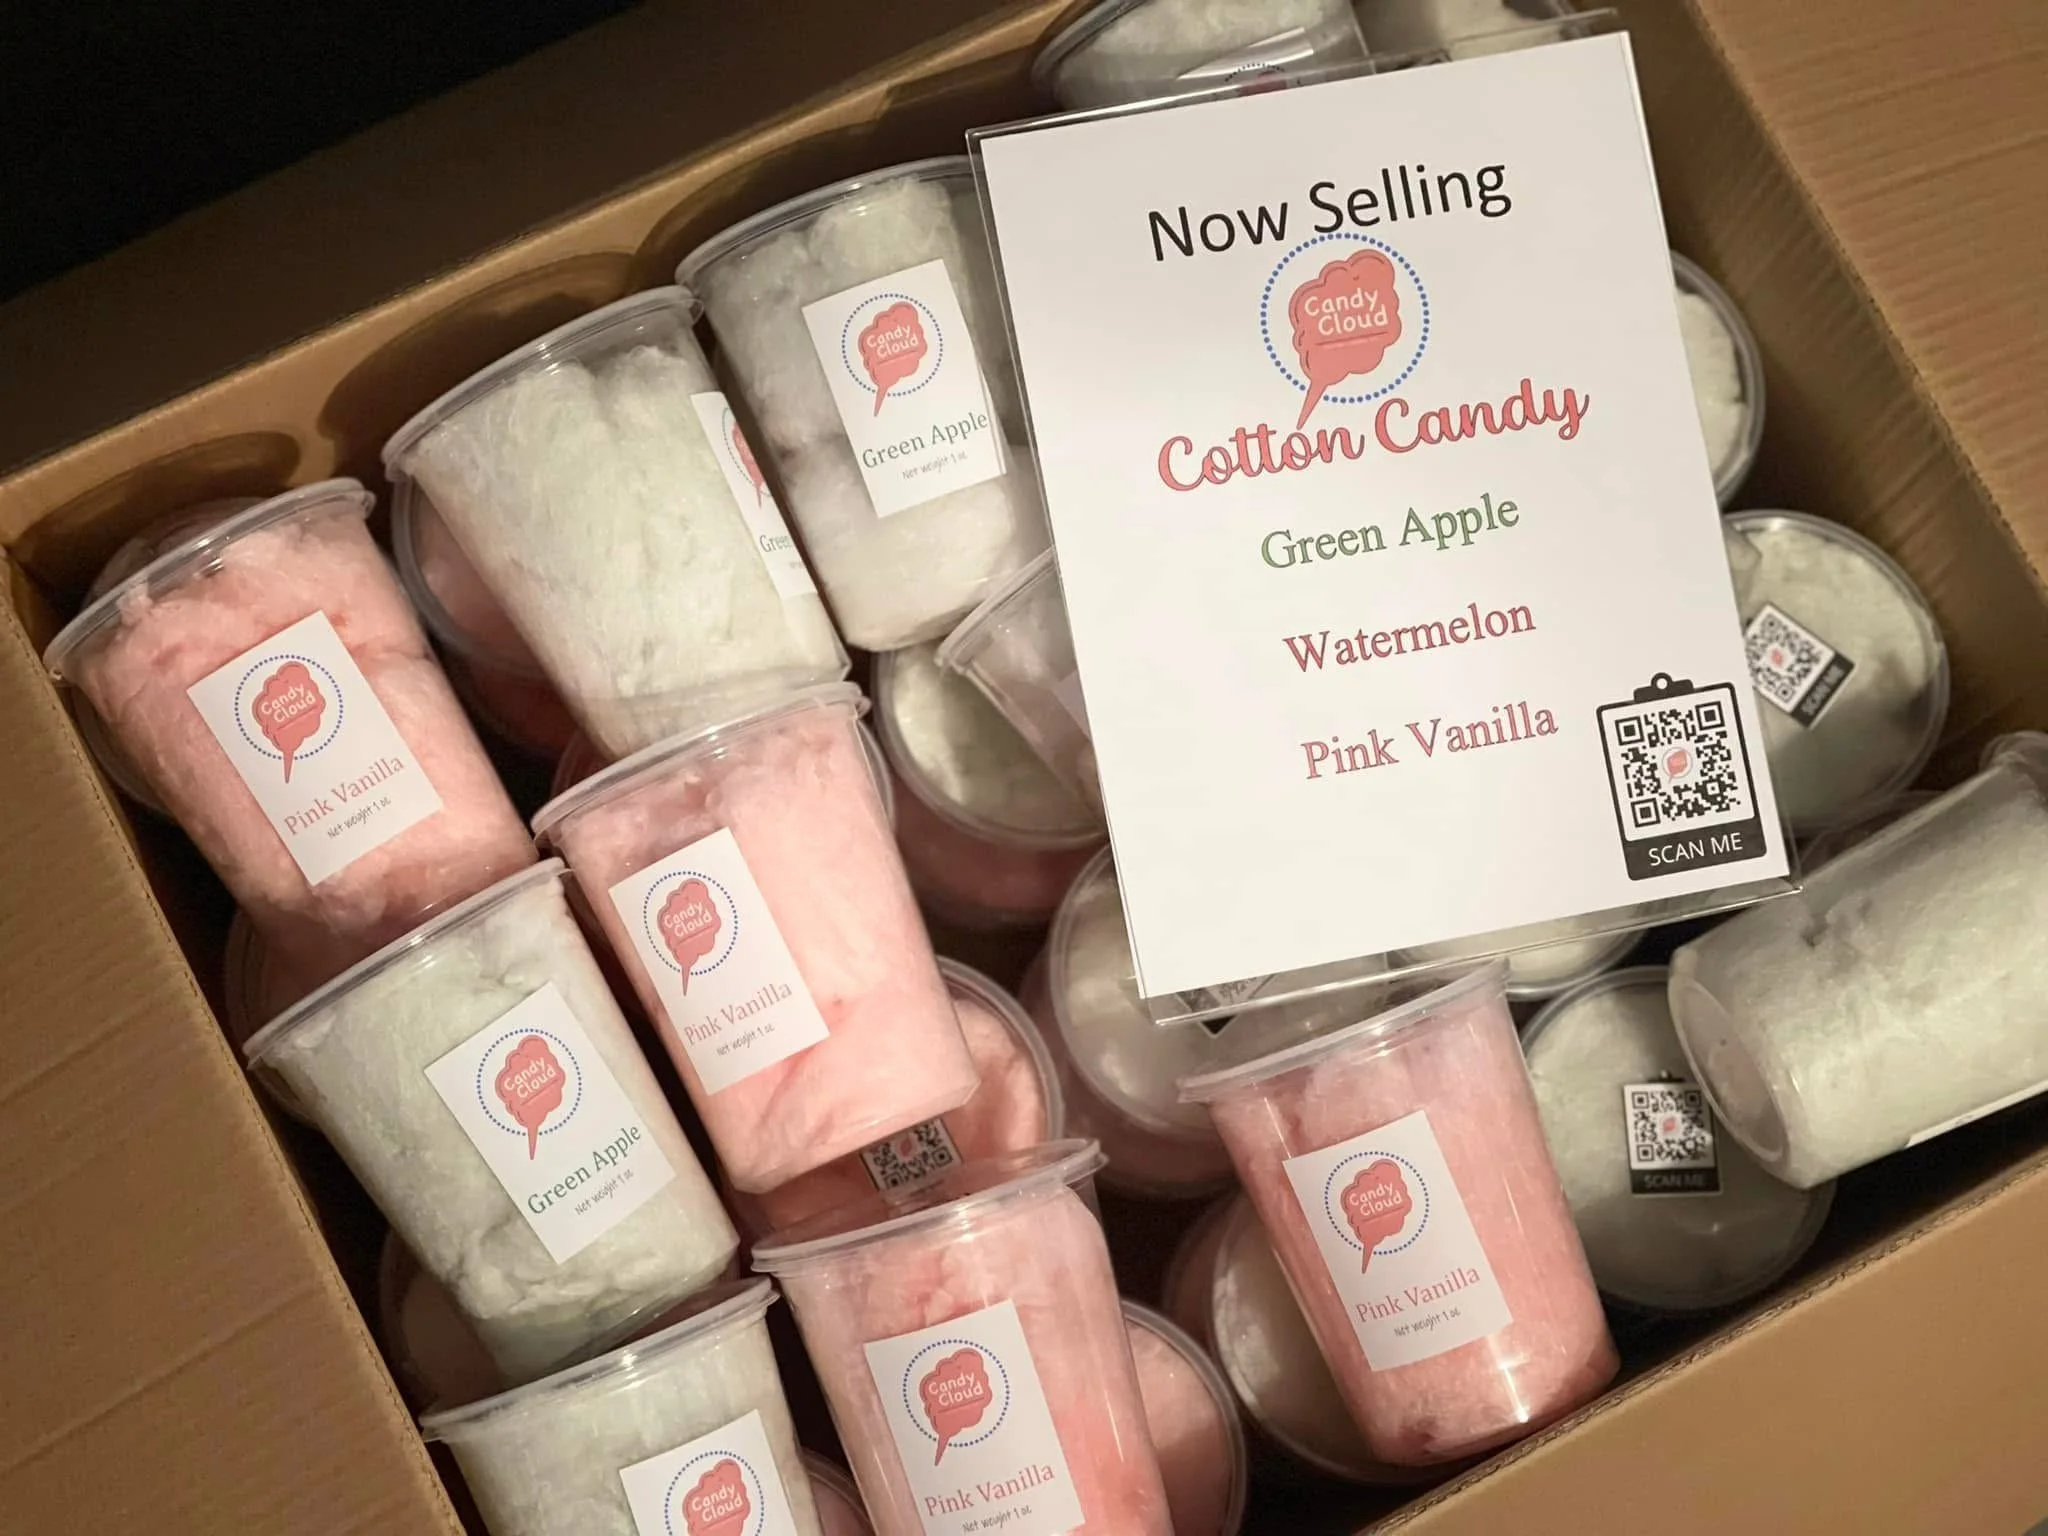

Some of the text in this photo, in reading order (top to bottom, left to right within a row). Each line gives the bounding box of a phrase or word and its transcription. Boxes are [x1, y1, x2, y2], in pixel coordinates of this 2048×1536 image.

[1148, 163, 1512, 262] Now Selling
[1304, 286, 1379, 317] Candy
[867, 325, 910, 348] Candy
[1317, 306, 1389, 338] Cloud
[877, 333, 918, 359] Cloud
[862, 411, 988, 469] Green Apple
[1158, 378, 1590, 491] Cotton Candy
[1261, 492, 1520, 570] Green Apple
[1283, 603, 1537, 674] Watermelon
[260, 684, 306, 716] Candy
[273, 693, 316, 724] Cloud
[1301, 700, 1559, 780] Pink Vanilla
[284, 757, 404, 835] Pink Vanilla
[1648, 832, 1743, 867] SCAN ME
[663, 901, 702, 929] Candy
[673, 911, 713, 938] Cloud
[684, 983, 792, 1045] Pink Vanilla
[503, 1057, 546, 1092] Candy
[516, 1064, 557, 1099] Cloud
[527, 1126, 641, 1214] Green Apple
[1350, 1182, 1394, 1206] Candy
[1360, 1192, 1402, 1217] Cloud
[1355, 1267, 1480, 1323] Pink Vanilla
[928, 1372, 974, 1395] Candy
[938, 1380, 984, 1406] Cloud
[691, 1483, 735, 1512] Candy
[924, 1464, 1054, 1516] Pink Vanilla
[702, 1492, 743, 1522] Cloud
